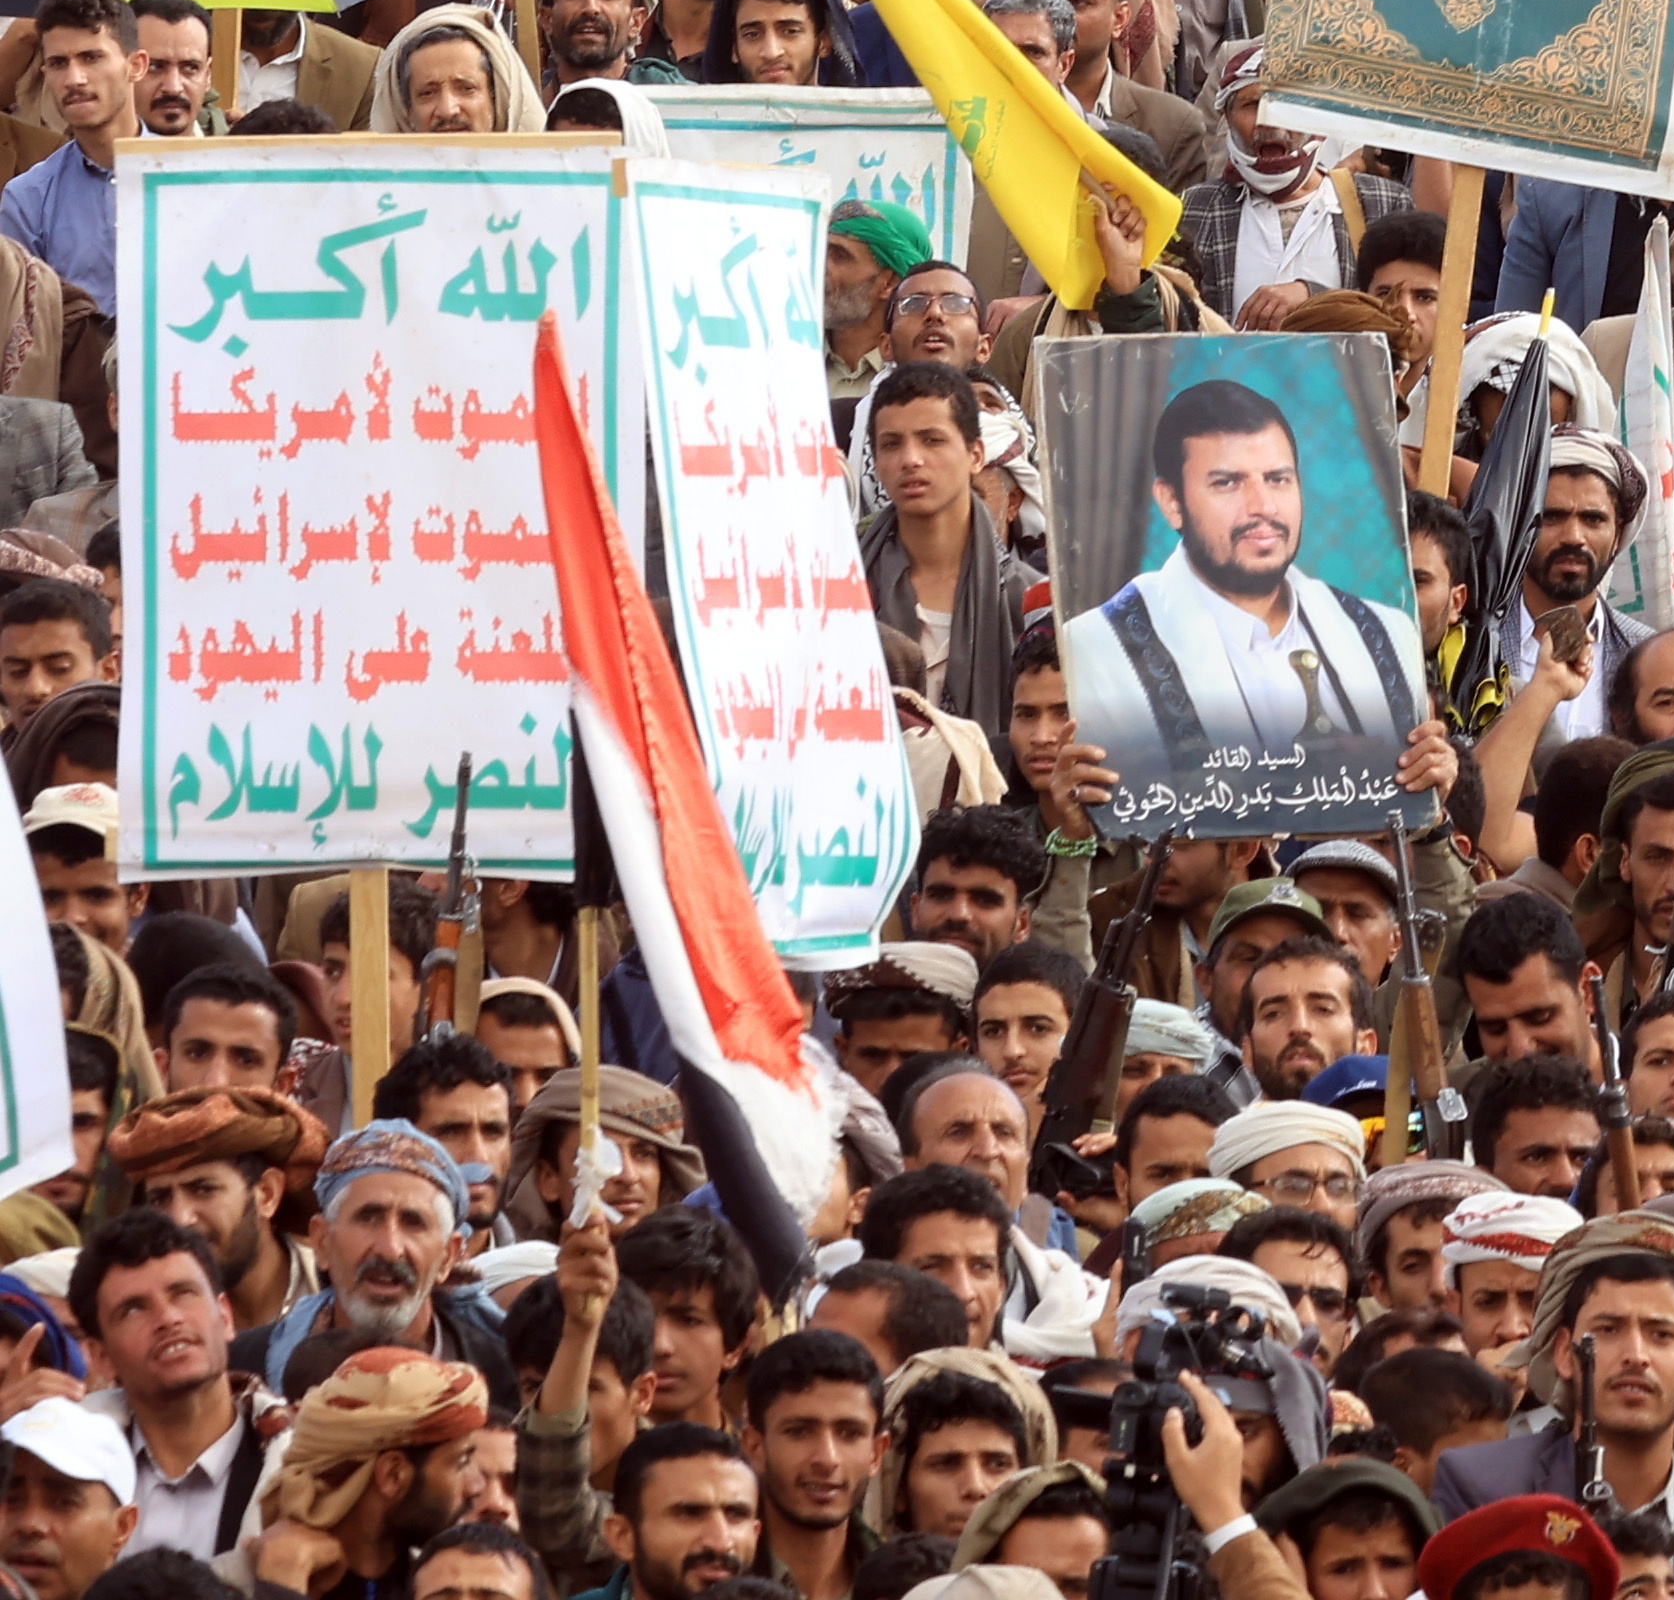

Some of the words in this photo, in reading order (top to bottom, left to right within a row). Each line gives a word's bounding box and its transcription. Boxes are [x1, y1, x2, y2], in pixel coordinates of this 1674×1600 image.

[167, 194, 427, 358] أكبر
[438, 213, 591, 322] الله
[171, 352, 392, 460] لأمريكا
[169, 488, 392, 584] لإسرائيل
[168, 610, 324, 702] اليهود
[344, 612, 432, 702] على
[169, 724, 383, 845] للإسلام
[1203, 745, 1251, 771] القائد
[1258, 743, 1305, 770] السيد
